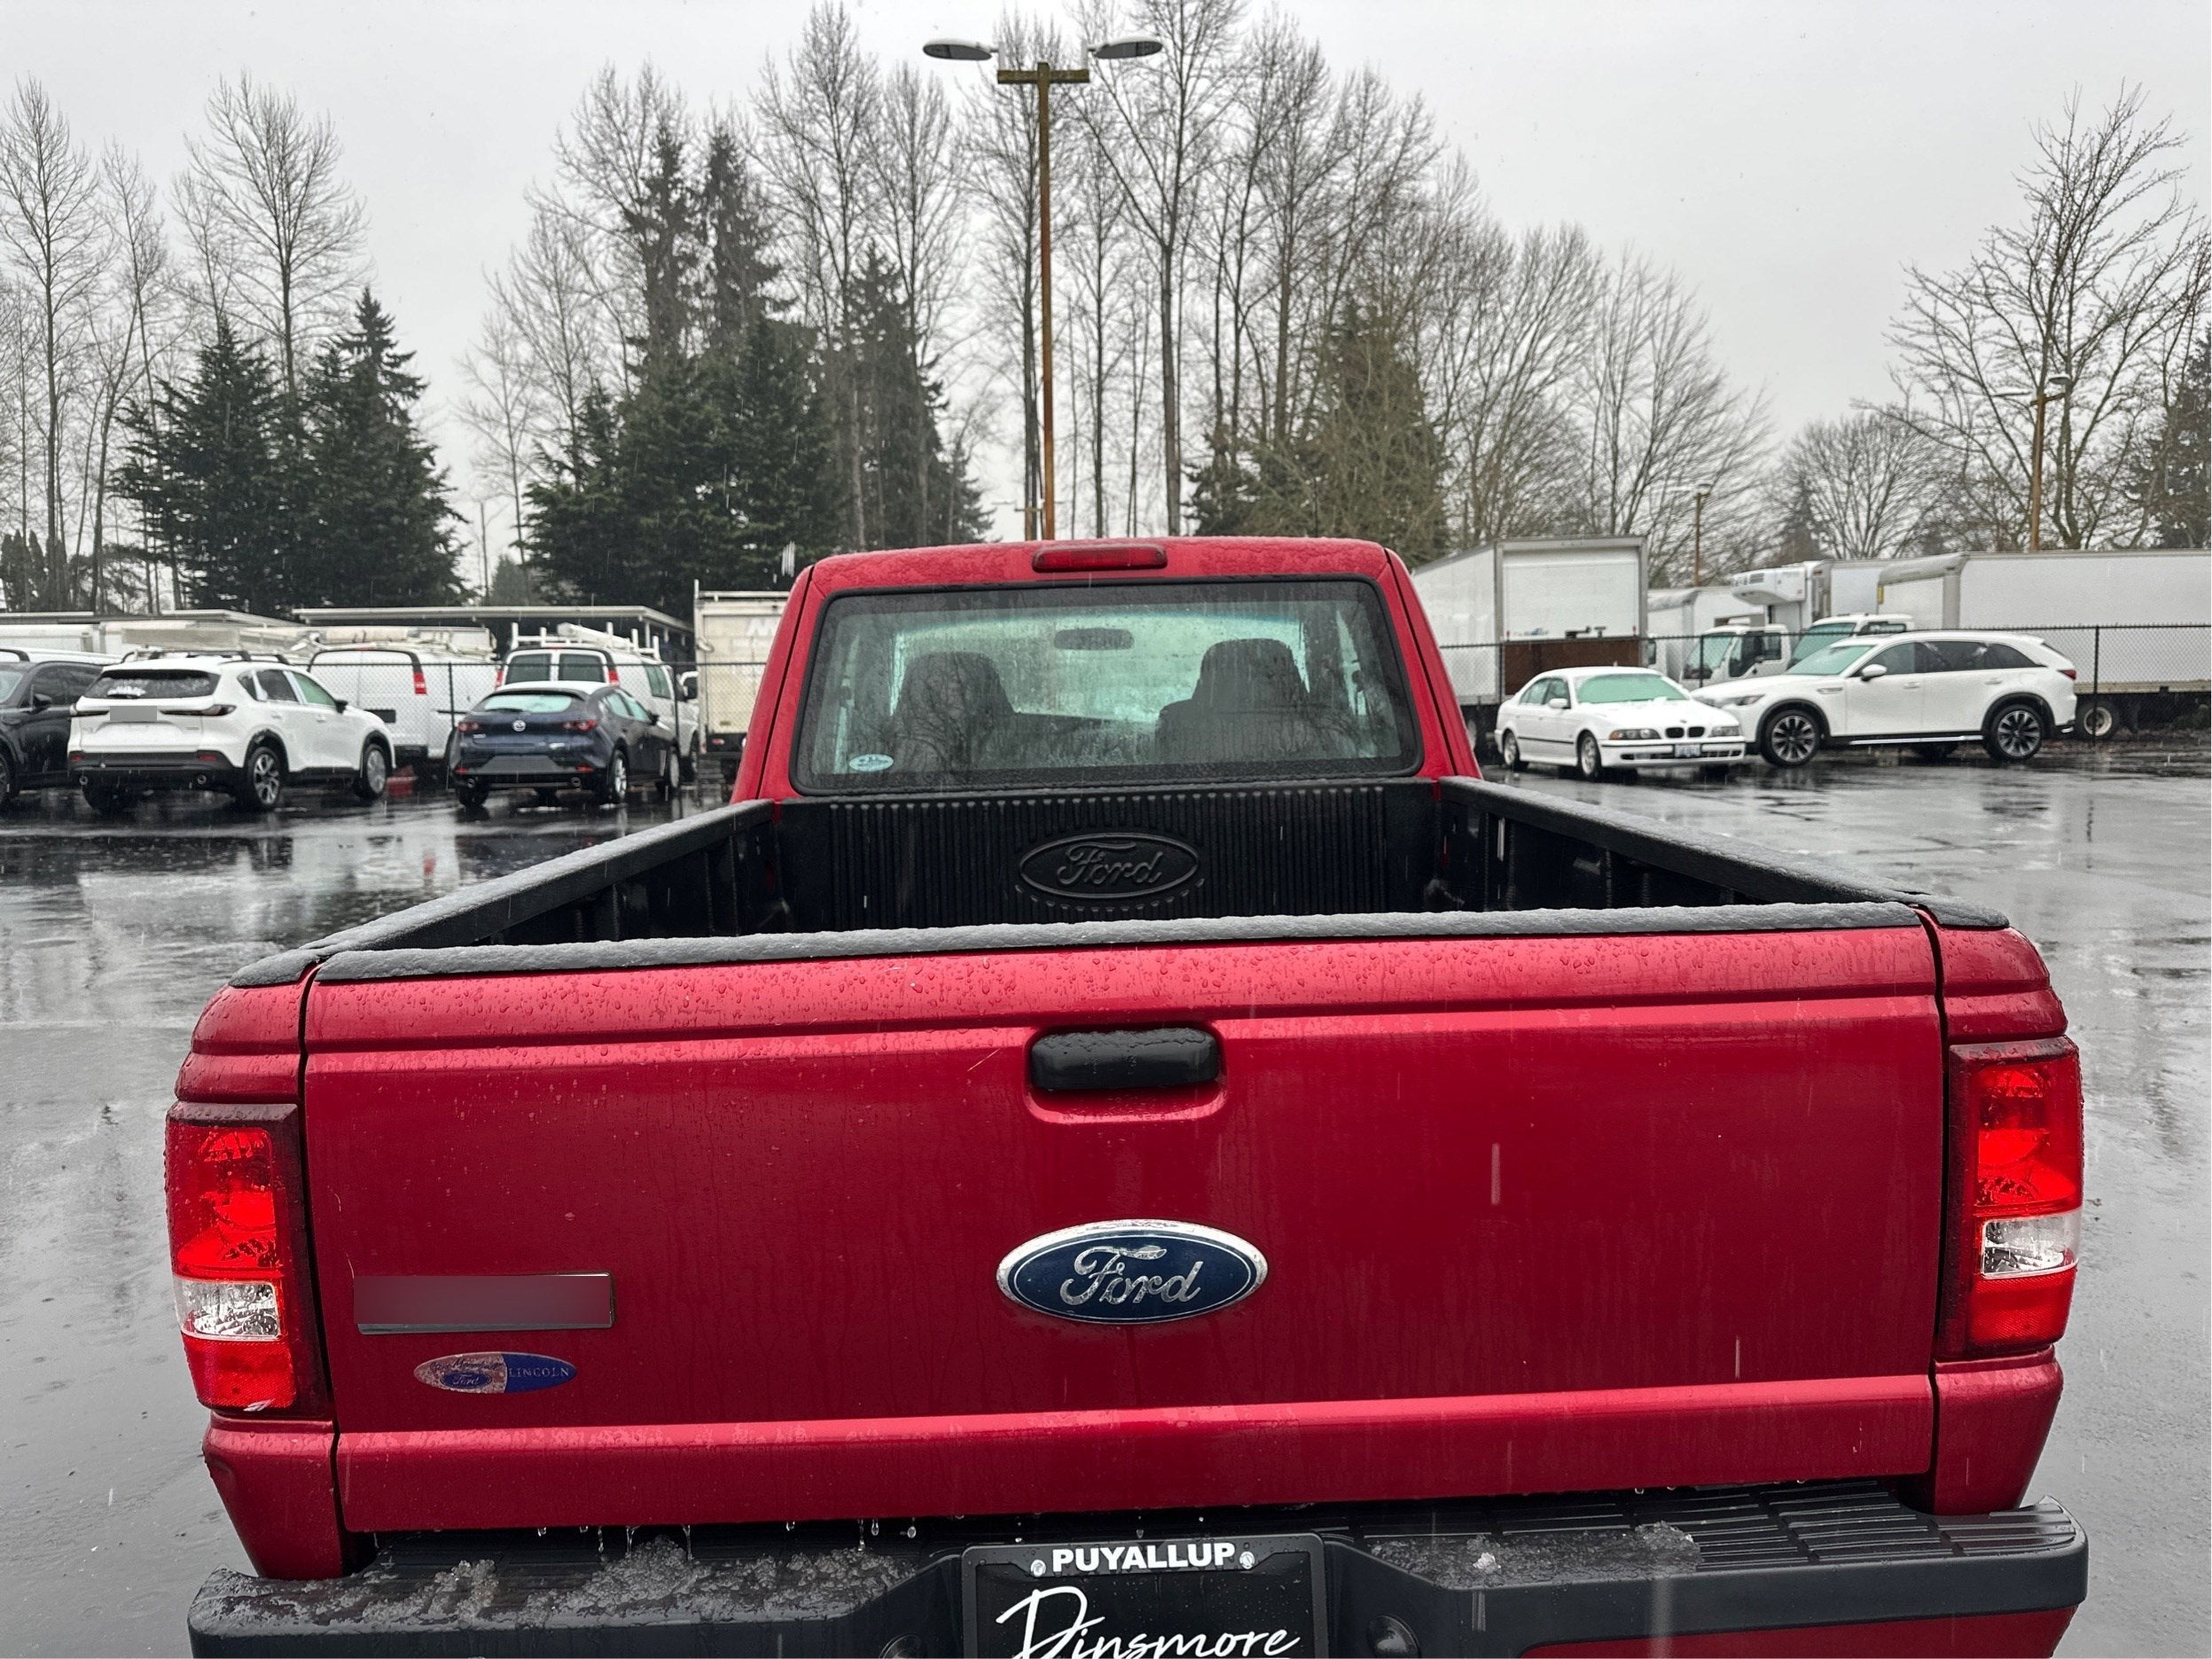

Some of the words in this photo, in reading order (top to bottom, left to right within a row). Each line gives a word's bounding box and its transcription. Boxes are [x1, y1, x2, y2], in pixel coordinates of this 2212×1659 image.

[1057, 842, 1163, 885] Ford
[1059, 1245, 1204, 1306] Ford
[452, 1373, 480, 1386] Ford
[508, 1367, 570, 1378] LINCOLN
[1052, 1542, 1236, 1573] PUYALLUP
[996, 1585, 1301, 1659] Dinsmore
